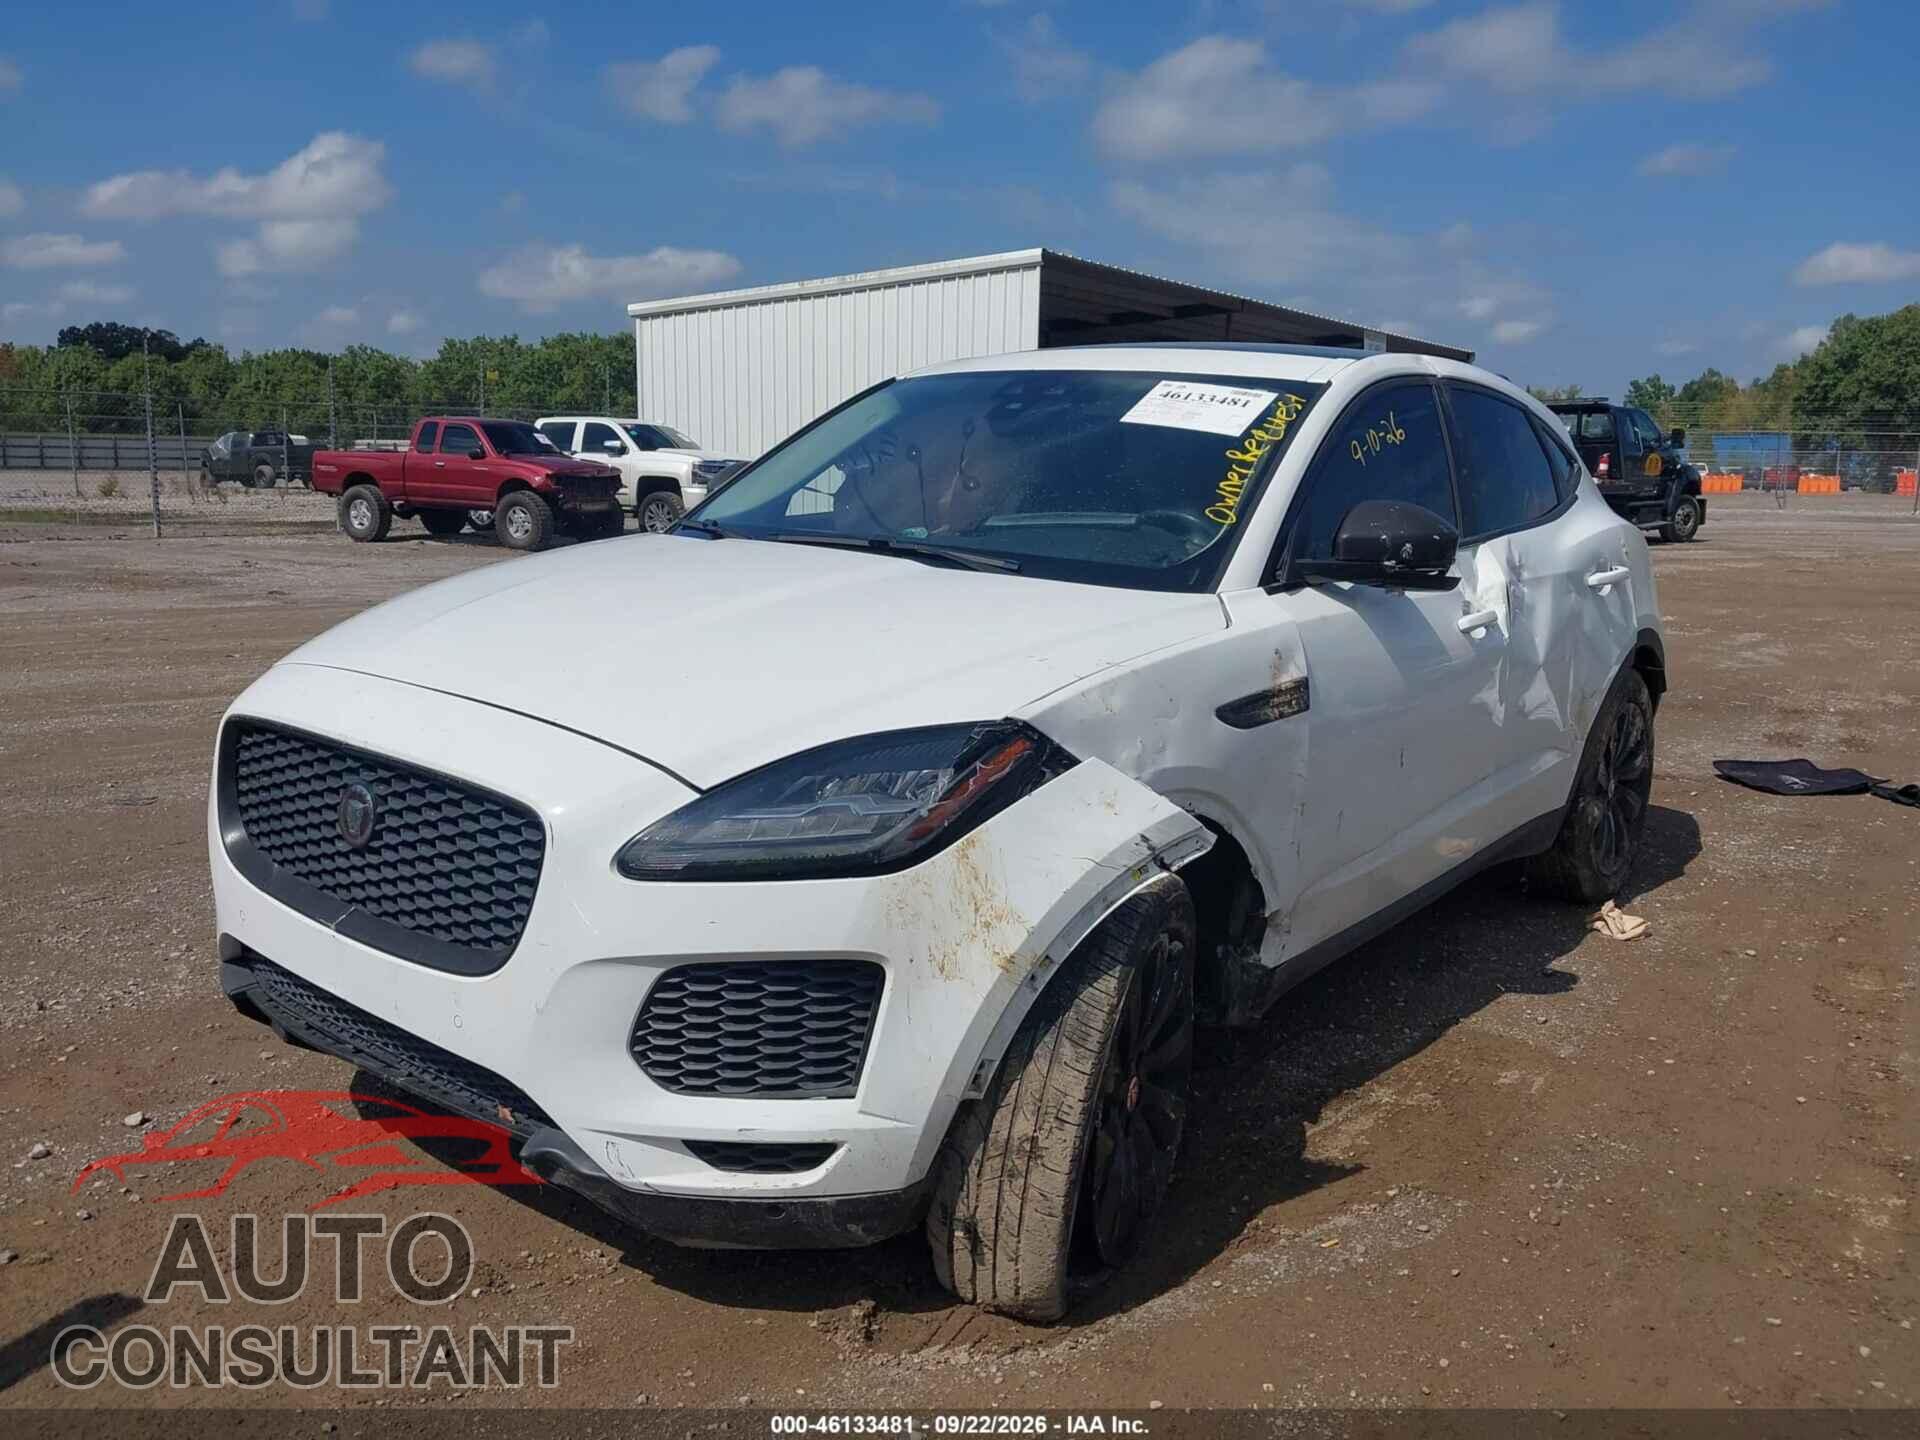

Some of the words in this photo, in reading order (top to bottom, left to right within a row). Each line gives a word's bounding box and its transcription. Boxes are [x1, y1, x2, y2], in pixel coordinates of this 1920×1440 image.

[1159, 390, 1251, 408] 46133481
[1225, 394, 1306, 462] Request
[1351, 411, 1405, 466] 9-10-26
[1205, 464, 1254, 523] Owner
